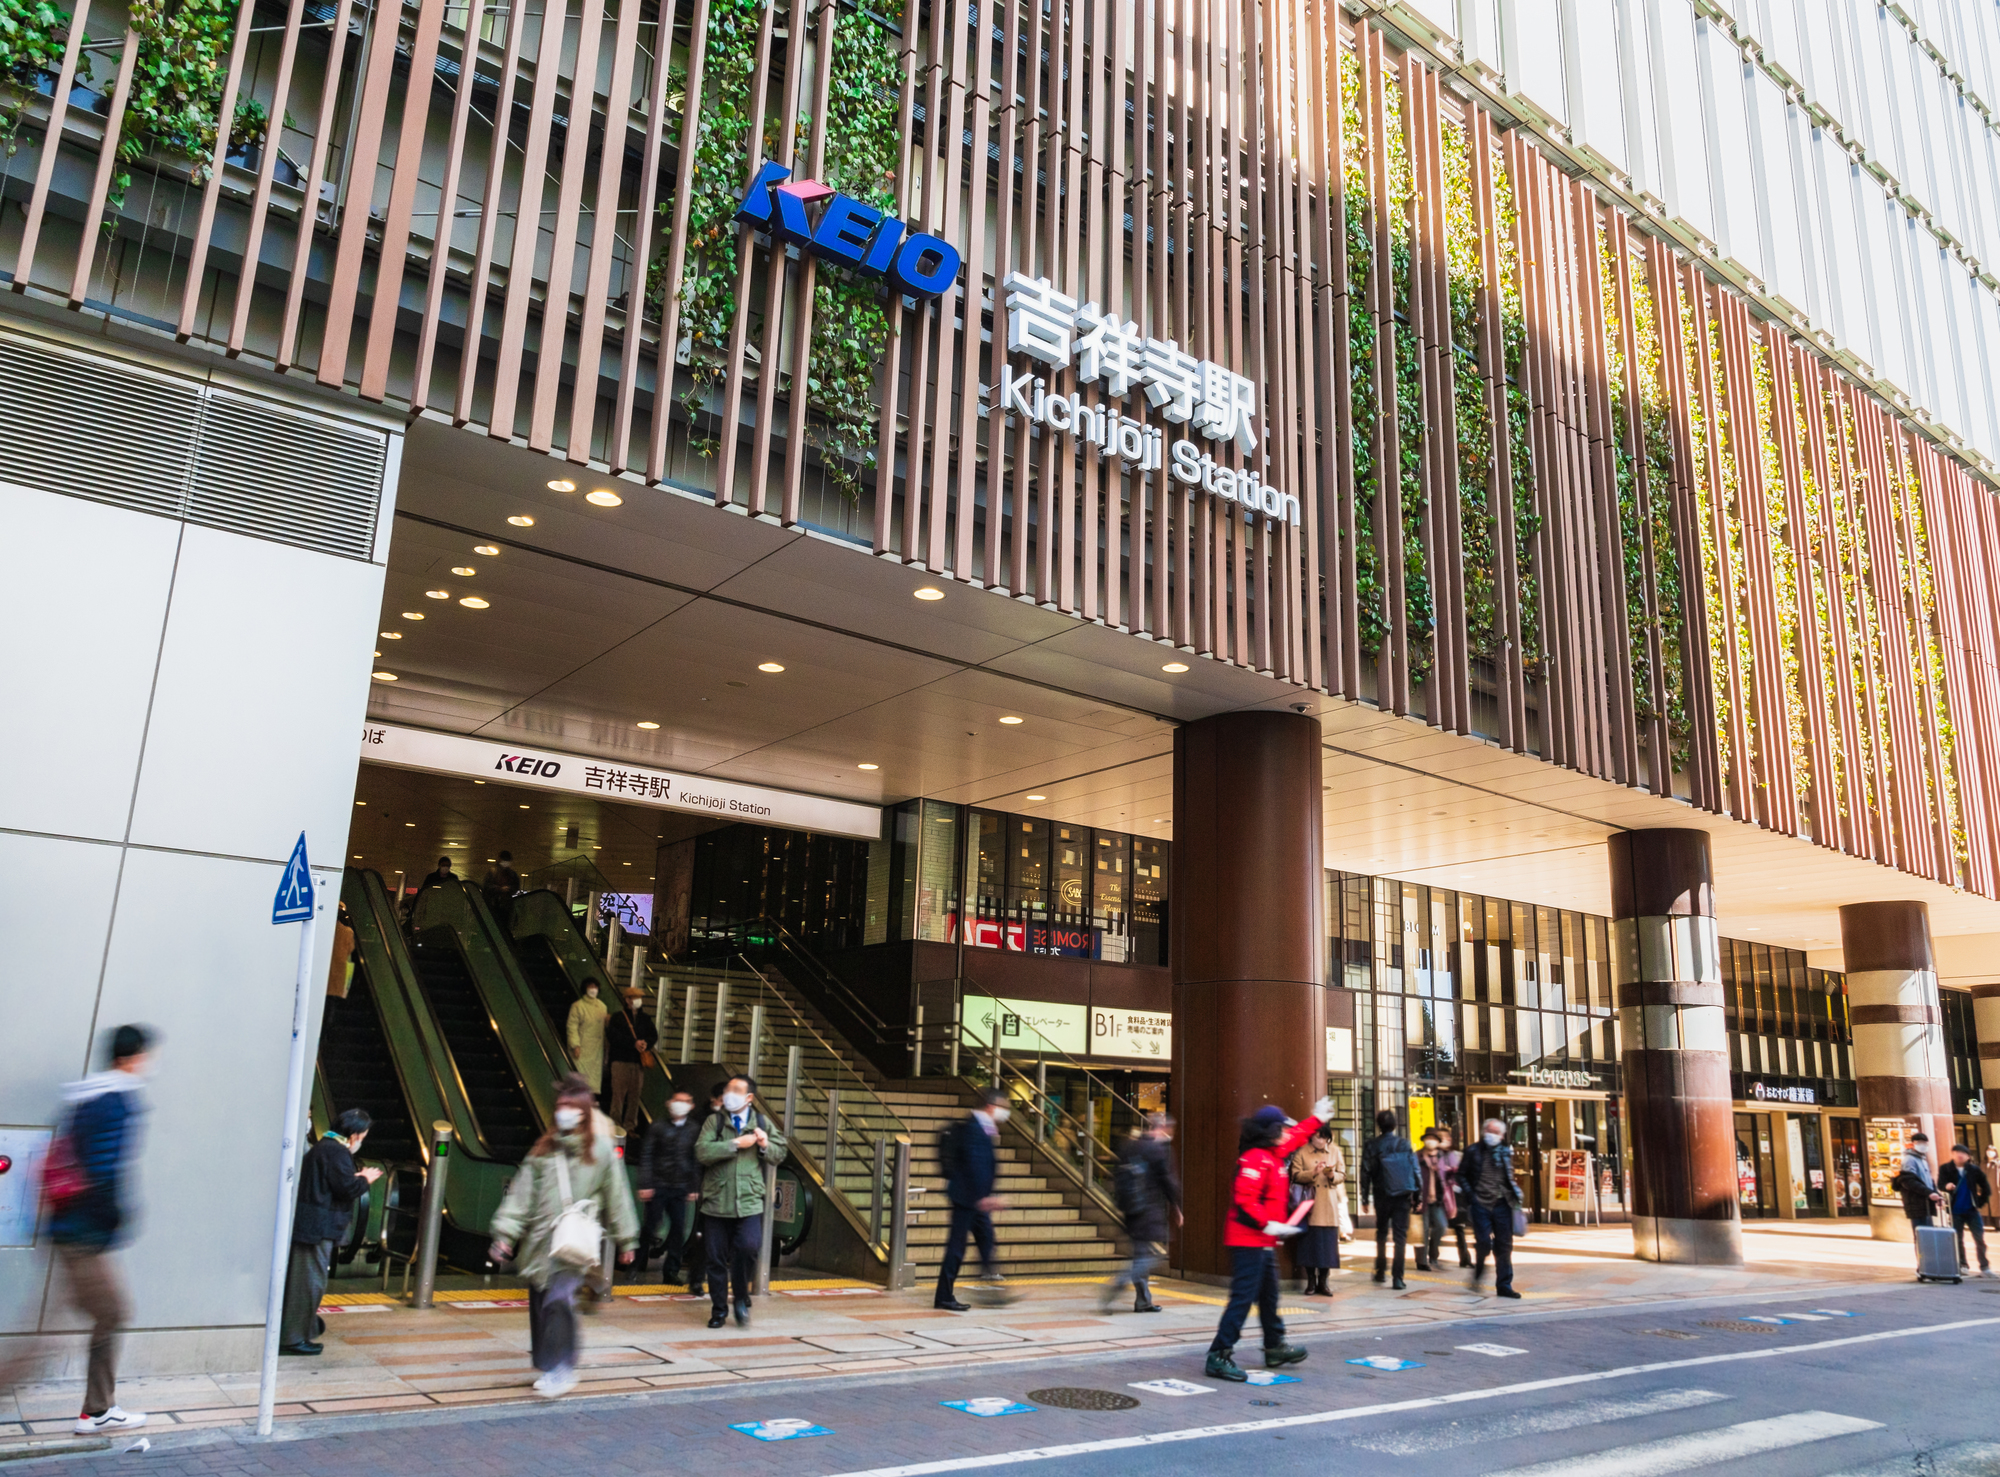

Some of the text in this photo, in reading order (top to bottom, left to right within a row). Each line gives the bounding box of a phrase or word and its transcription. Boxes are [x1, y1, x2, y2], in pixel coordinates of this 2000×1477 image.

[734, 160, 961, 299] KEIO
[1003, 270, 1258, 455] 吉祥寺駅
[1000, 363, 1301, 527] Kichijōji Station
[495, 754, 561, 778] KEIO
[585, 766, 671, 800] 吉祥寺駅
[729, 799, 771, 816] Station
[1024, 1016, 1071, 1028] エレベーター
[1530, 1065, 1591, 1090] Le repas
